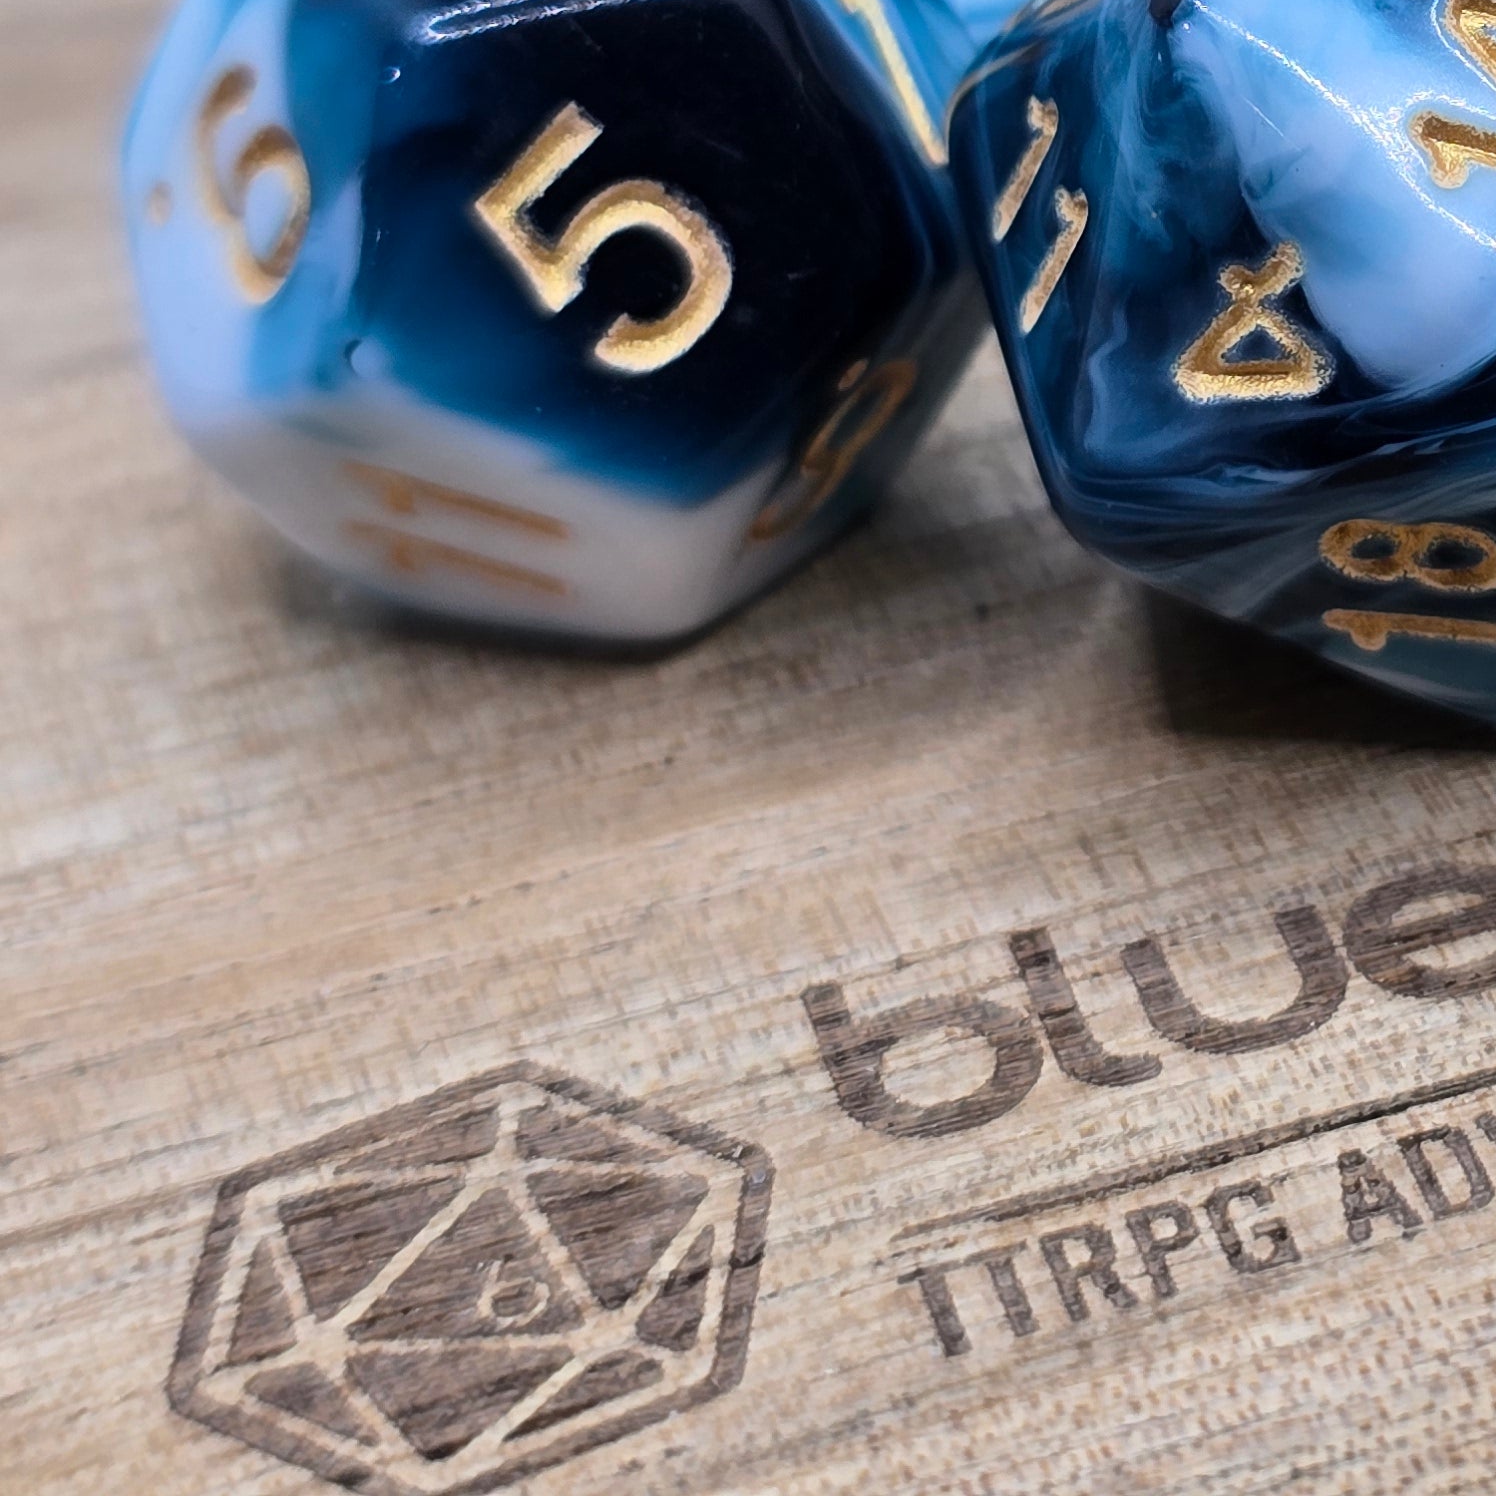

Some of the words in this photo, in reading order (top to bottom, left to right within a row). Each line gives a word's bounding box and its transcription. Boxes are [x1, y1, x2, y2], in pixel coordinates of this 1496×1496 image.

[475, 101, 734, 376] 5
[990, 96, 1092, 334] 11
[1170, 239, 1336, 406] 4
[896, 1178, 1303, 1358] TTRPG
